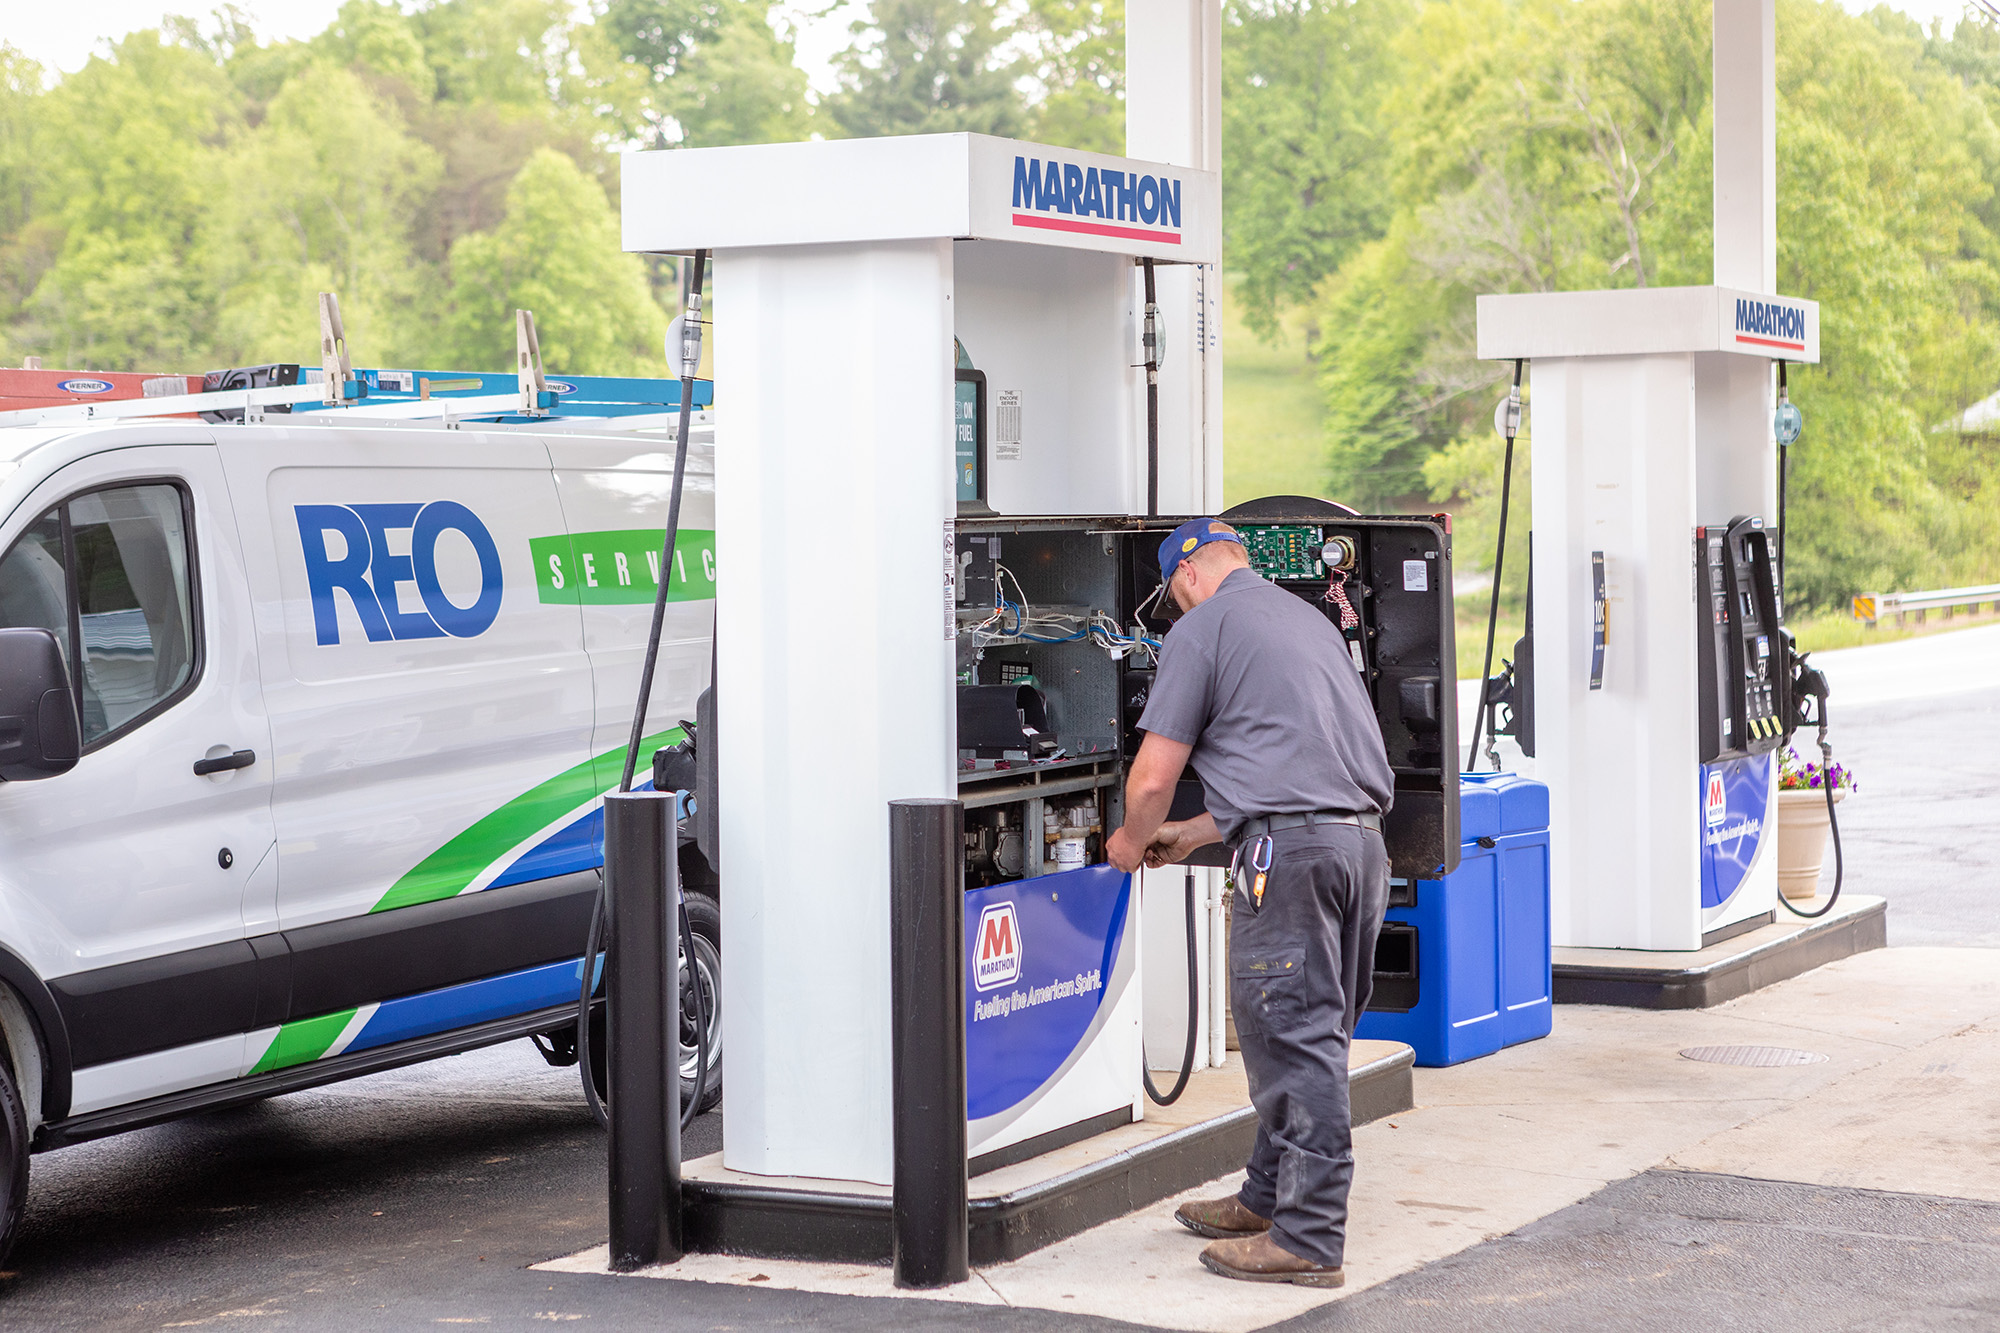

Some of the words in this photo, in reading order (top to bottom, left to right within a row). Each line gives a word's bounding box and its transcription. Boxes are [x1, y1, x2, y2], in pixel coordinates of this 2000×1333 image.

[1012, 156, 1181, 228] MARATHON
[1735, 298, 1804, 340] MARATHON
[963, 401, 973, 419] ON
[959, 424, 974, 442] FUEL
[293, 499, 504, 646] REO
[1710, 780, 1722, 807] M
[982, 916, 1013, 960] M
[980, 957, 1015, 977] MARATHON
[973, 994, 1010, 1022] Fueling
[1011, 990, 1027, 1012] the
[1027, 979, 1074, 1007] American
[1075, 968, 1103, 997] Spirit.
